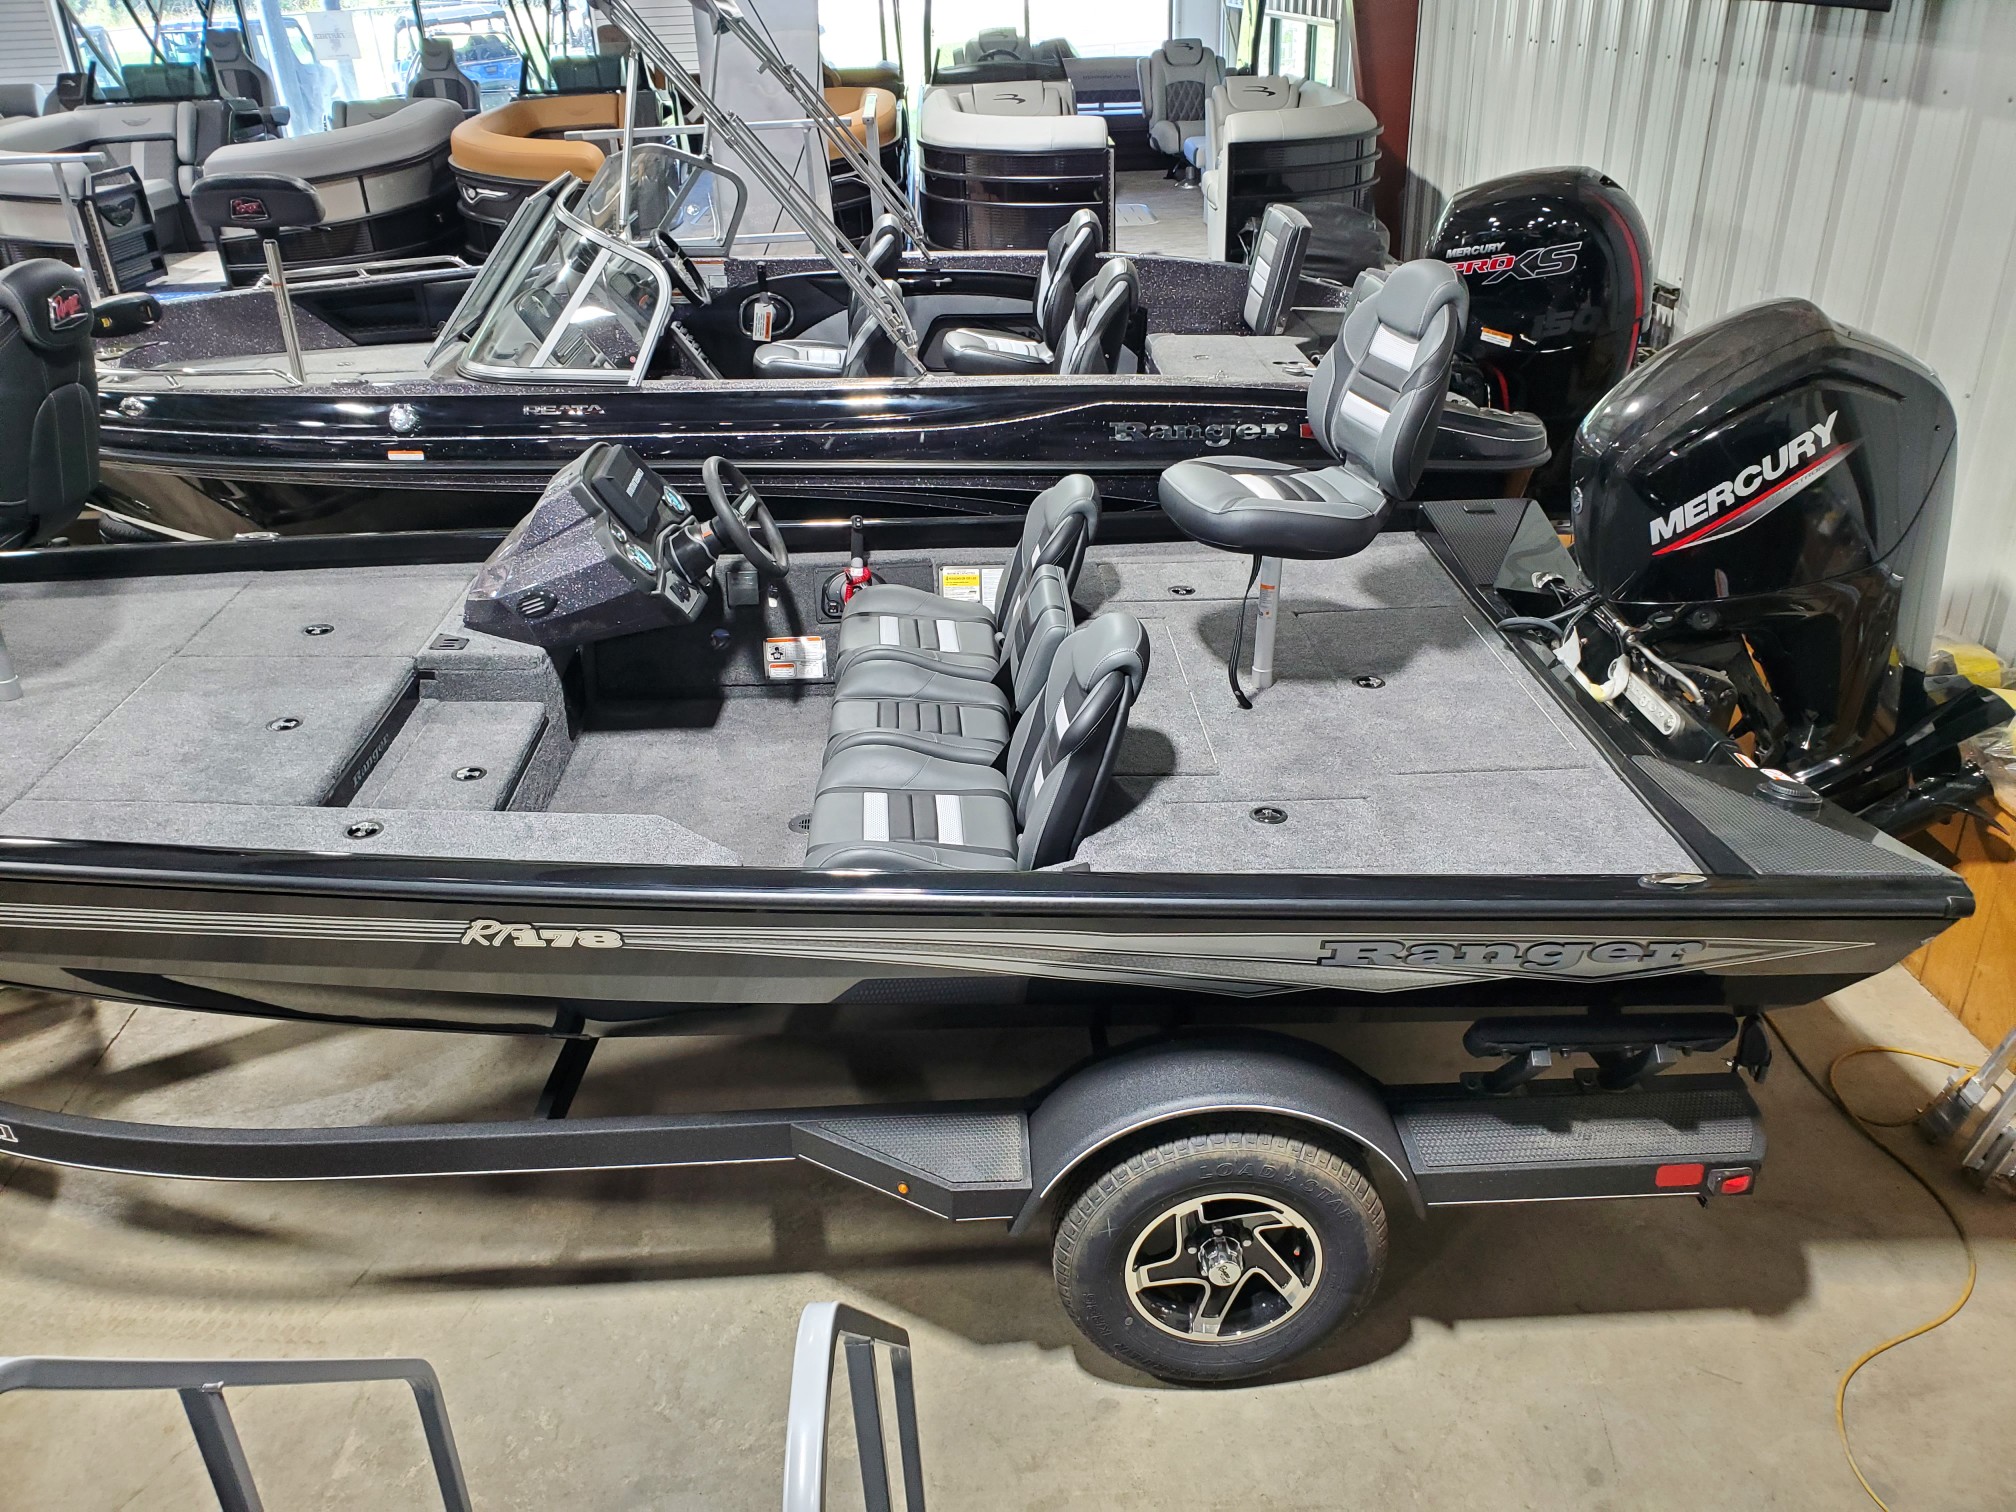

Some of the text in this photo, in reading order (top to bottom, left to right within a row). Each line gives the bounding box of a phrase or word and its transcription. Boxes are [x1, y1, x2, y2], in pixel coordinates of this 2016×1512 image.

[1446, 242, 1506, 259] MERCURY
[1530, 306, 1602, 338] 150
[523, 404, 606, 416] REATA
[1108, 421, 1289, 448] Ranger
[1649, 409, 1839, 546] MERCURY
[352, 733, 389, 791] Ranger
[1316, 938, 1707, 972] Ranger
[1198, 1162, 1355, 1226] LOAD STAR
